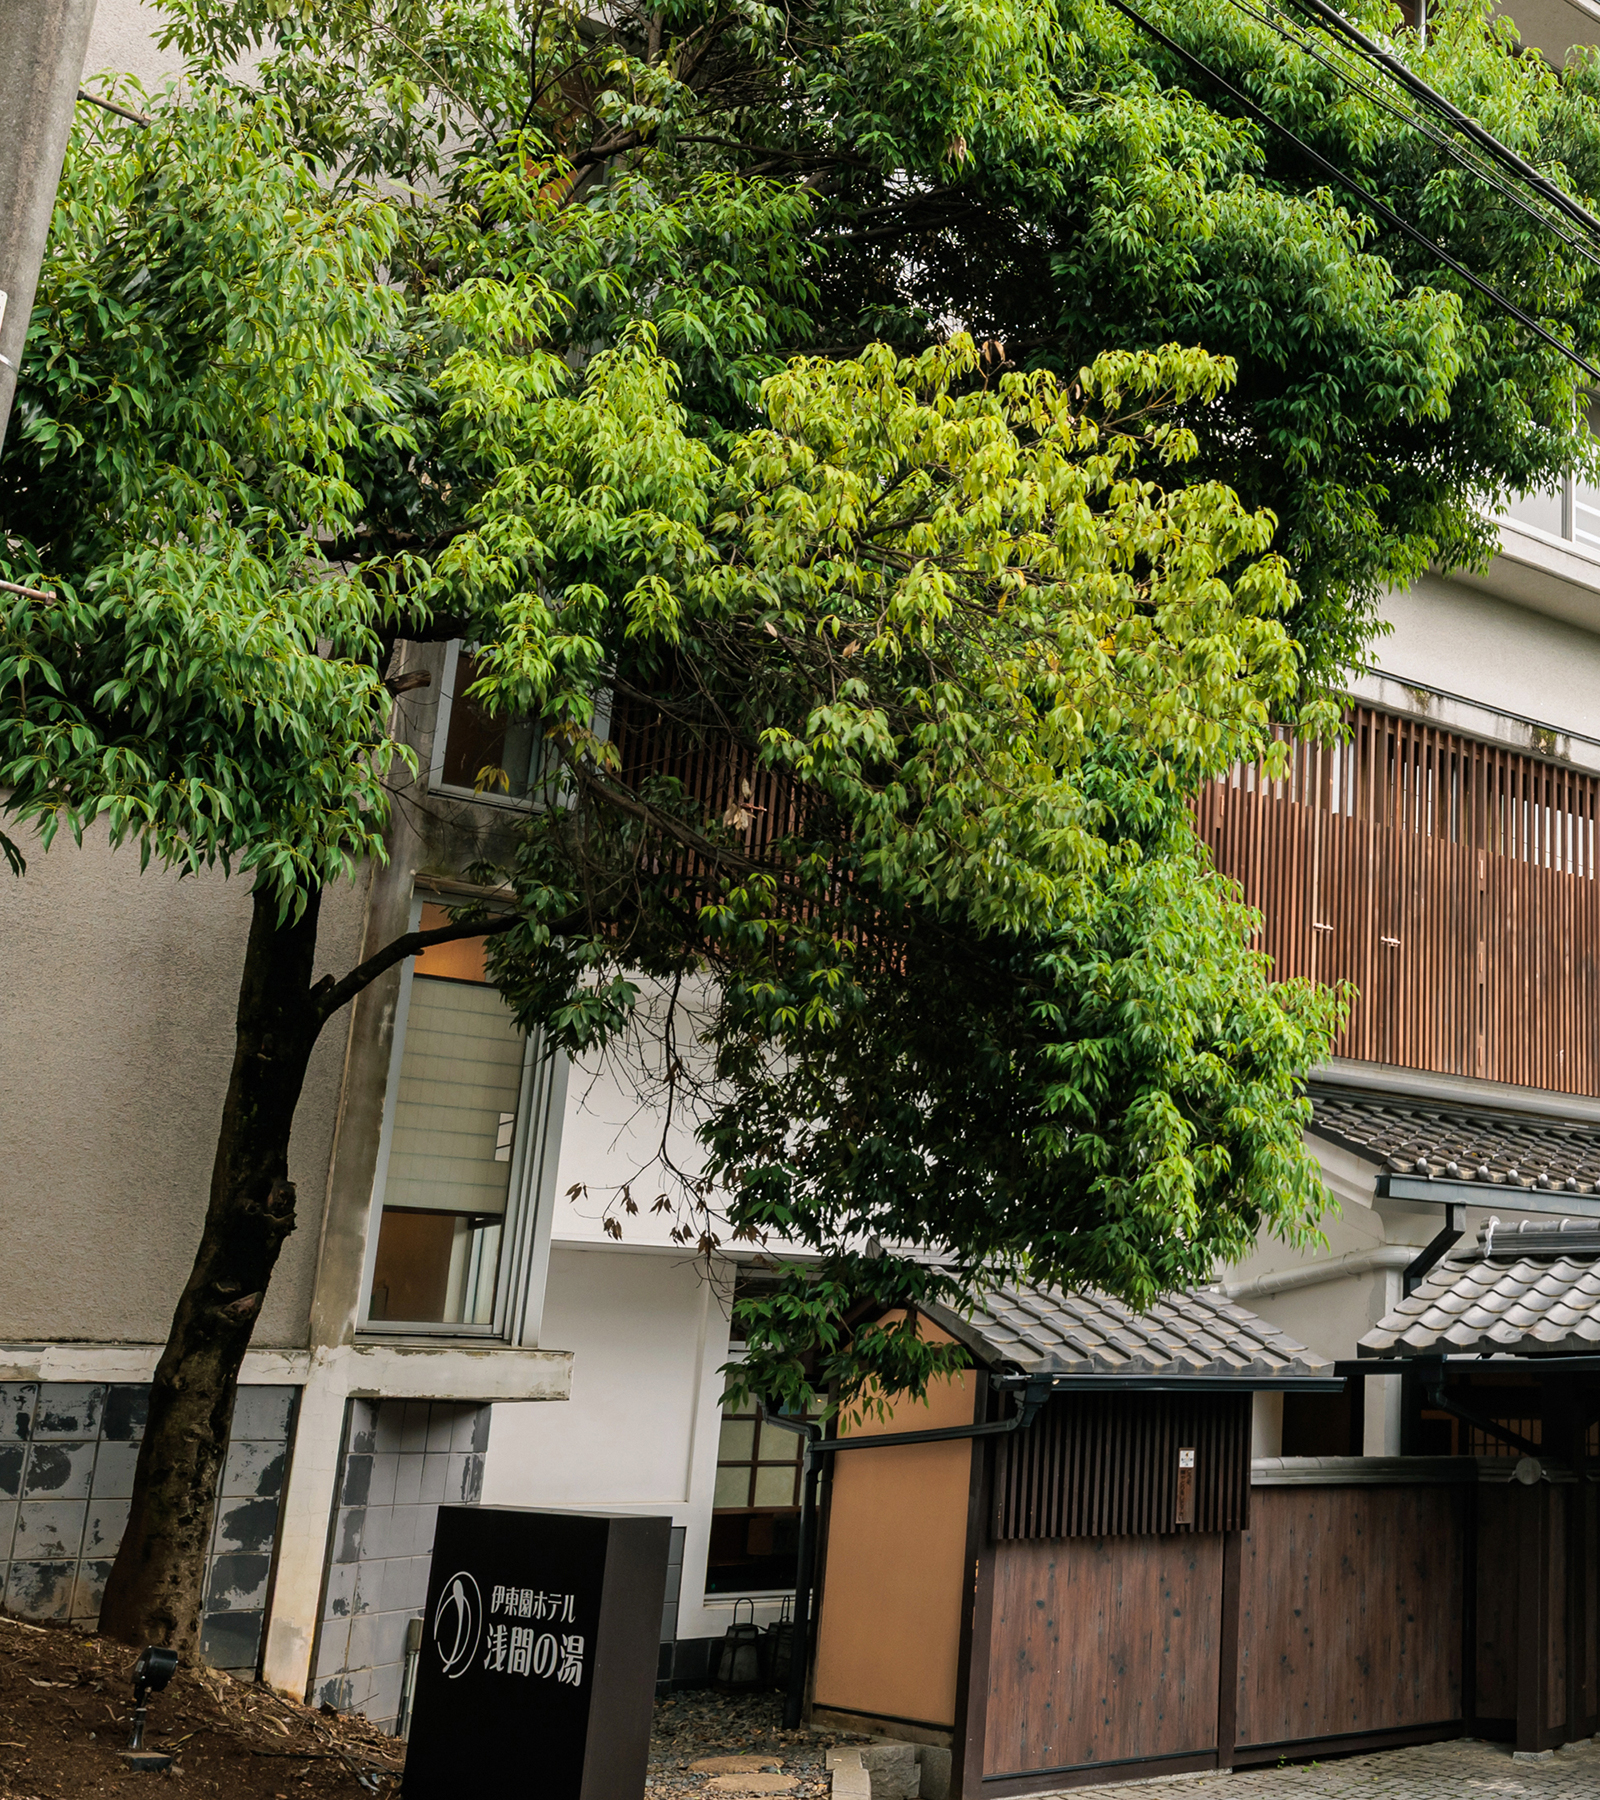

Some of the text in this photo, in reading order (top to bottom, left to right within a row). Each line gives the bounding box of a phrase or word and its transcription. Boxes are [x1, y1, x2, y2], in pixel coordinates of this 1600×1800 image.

[490, 1585, 576, 1624] 伊東園ホテル
[483, 1623, 585, 1687] 浅間の湯
